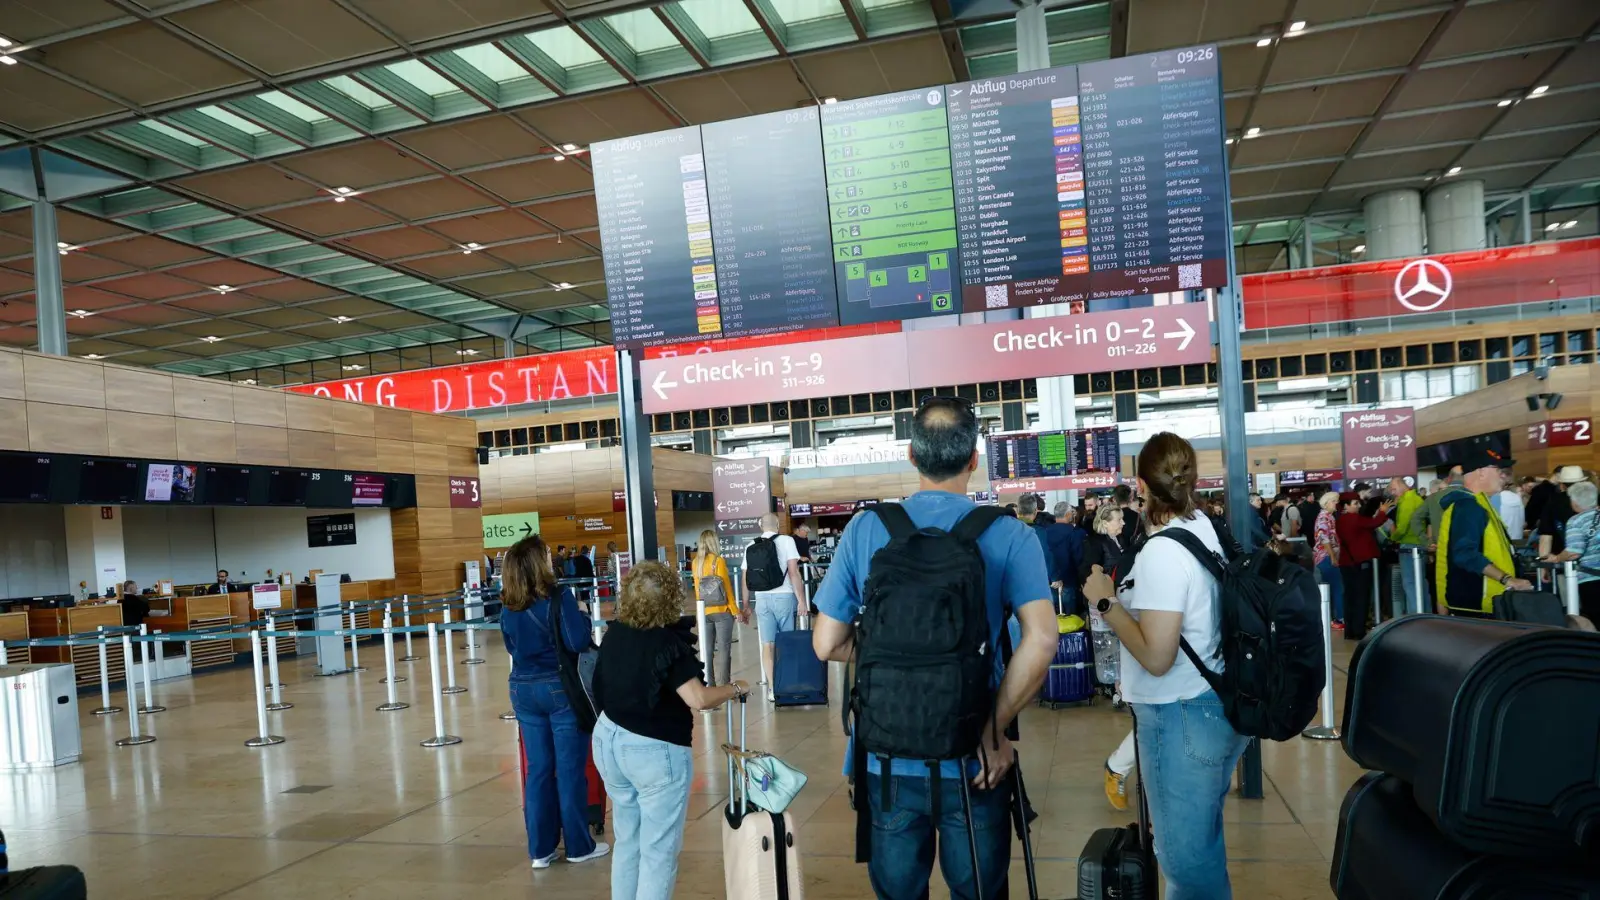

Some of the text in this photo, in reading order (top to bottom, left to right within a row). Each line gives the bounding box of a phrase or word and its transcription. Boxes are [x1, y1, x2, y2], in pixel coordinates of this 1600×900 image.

[969, 46, 1213, 97] Abflug Departure 09:26
[1162, 109, 1198, 121] Abfertigung
[972, 118, 999, 127] München
[610, 137, 642, 155] Abflug
[974, 147, 997, 155] Mailand
[975, 154, 1011, 166] Kopenhagen
[976, 176, 989, 184] Split
[1177, 148, 1198, 156] Service
[975, 164, 1005, 175] Zakynthos
[977, 184, 995, 192] Zürich
[1164, 160, 1176, 168] Self
[1177, 158, 1198, 166] Service
[978, 177, 1199, 210] Amsterdam 811-816 Self Service
[992, 191, 1014, 199] Canaria
[1119, 174, 1146, 183] 611-616
[979, 211, 998, 219] Dublin
[1166, 186, 1202, 198] Abfertigung
[980, 219, 1008, 229] Hurghada
[1121, 202, 1147, 211] 611-616
[980, 229, 1008, 237] Frankfurt
[1122, 212, 1148, 220] 421-426
[1180, 206, 1201, 214] Service
[981, 238, 1004, 246] Istanbul
[1005, 236, 1026, 245] Airport
[1123, 221, 1148, 229] 911-916
[1167, 215, 1203, 226] Abfertigung
[982, 247, 1009, 255] München
[1181, 225, 1202, 233] Service
[781, 244, 811, 254] Abfertigung
[982, 256, 1004, 264] London
[1168, 234, 1204, 245] Abfertigung
[935, 257, 940, 265] 1
[983, 265, 1009, 273] Teneriffa
[1182, 243, 1203, 251] Service
[852, 267, 859, 275] 5
[912, 268, 919, 278] 2
[984, 274, 1012, 282] Barcelona
[1182, 253, 1203, 261] Service
[1149, 265, 1169, 273] further
[875, 274, 881, 282] 4
[1014, 277, 1059, 288] Weitere Abflüge
[1138, 273, 1170, 284] Departures
[785, 287, 815, 297] Abfertigung
[1050, 293, 1083, 302] Großgepäck
[1093, 290, 1109, 298] Bulky
[1109, 288, 1135, 297] Baggage
[936, 297, 946, 307] T2
[652, 338, 665, 346] jeder
[665, 333, 712, 344] Sicherheitskontrolle
[724, 329, 747, 337] sämtliche
[748, 326, 778, 335] Abfluggates
[778, 323, 804, 331] erreichbar
[993, 318, 1155, 352] Check-in 0–2
[1107, 342, 1157, 357] 011–226
[683, 352, 823, 384] Check-in 3–9
[782, 375, 825, 388] 311–926
[1574, 420, 1590, 440] 2
[1365, 434, 1399, 443] Check-in
[1362, 455, 1395, 463] Check-in
[1362, 463, 1378, 471] 3–9
[471, 481, 478, 502] 3
[730, 481, 755, 489] Check-in
[483, 524, 515, 538] ates
